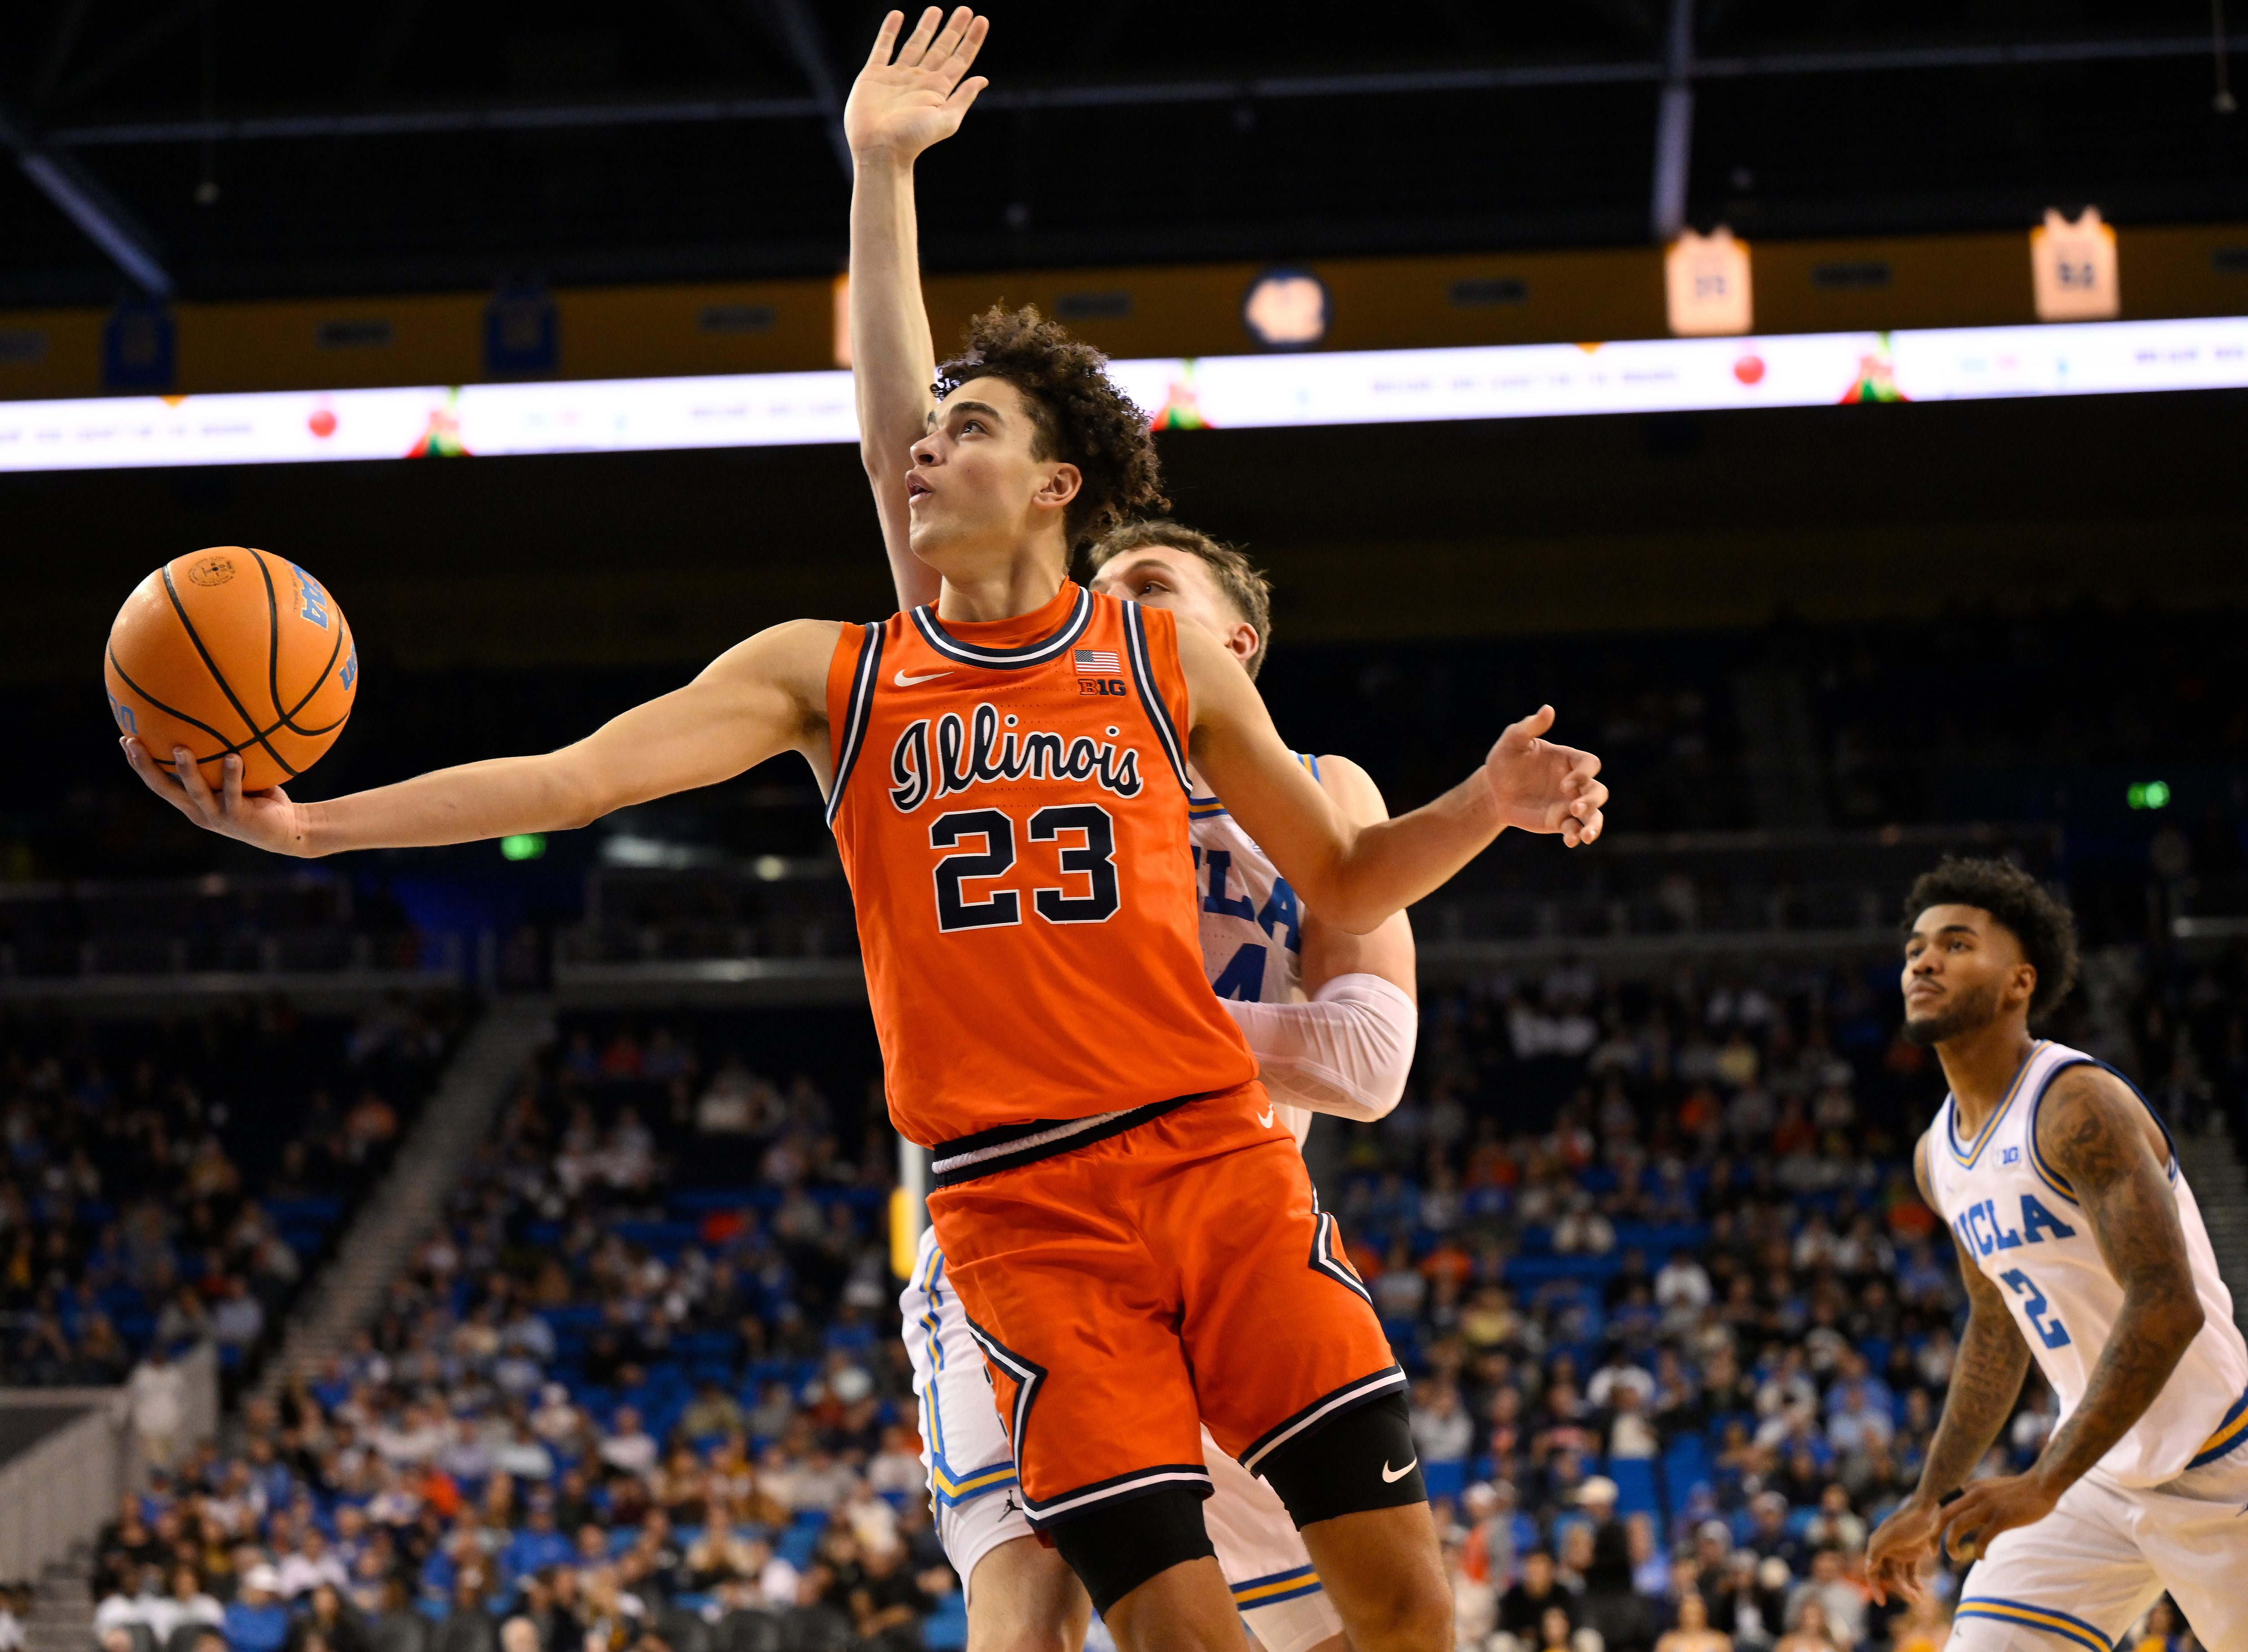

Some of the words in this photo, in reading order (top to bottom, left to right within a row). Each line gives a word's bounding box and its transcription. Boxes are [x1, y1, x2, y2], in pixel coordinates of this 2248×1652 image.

[285, 558, 329, 631] CAA
[888, 702, 1144, 813] Illinois
[928, 803, 1122, 933] 23
[1191, 845, 1303, 955] LA
[1999, 1268, 2071, 1350] 2
